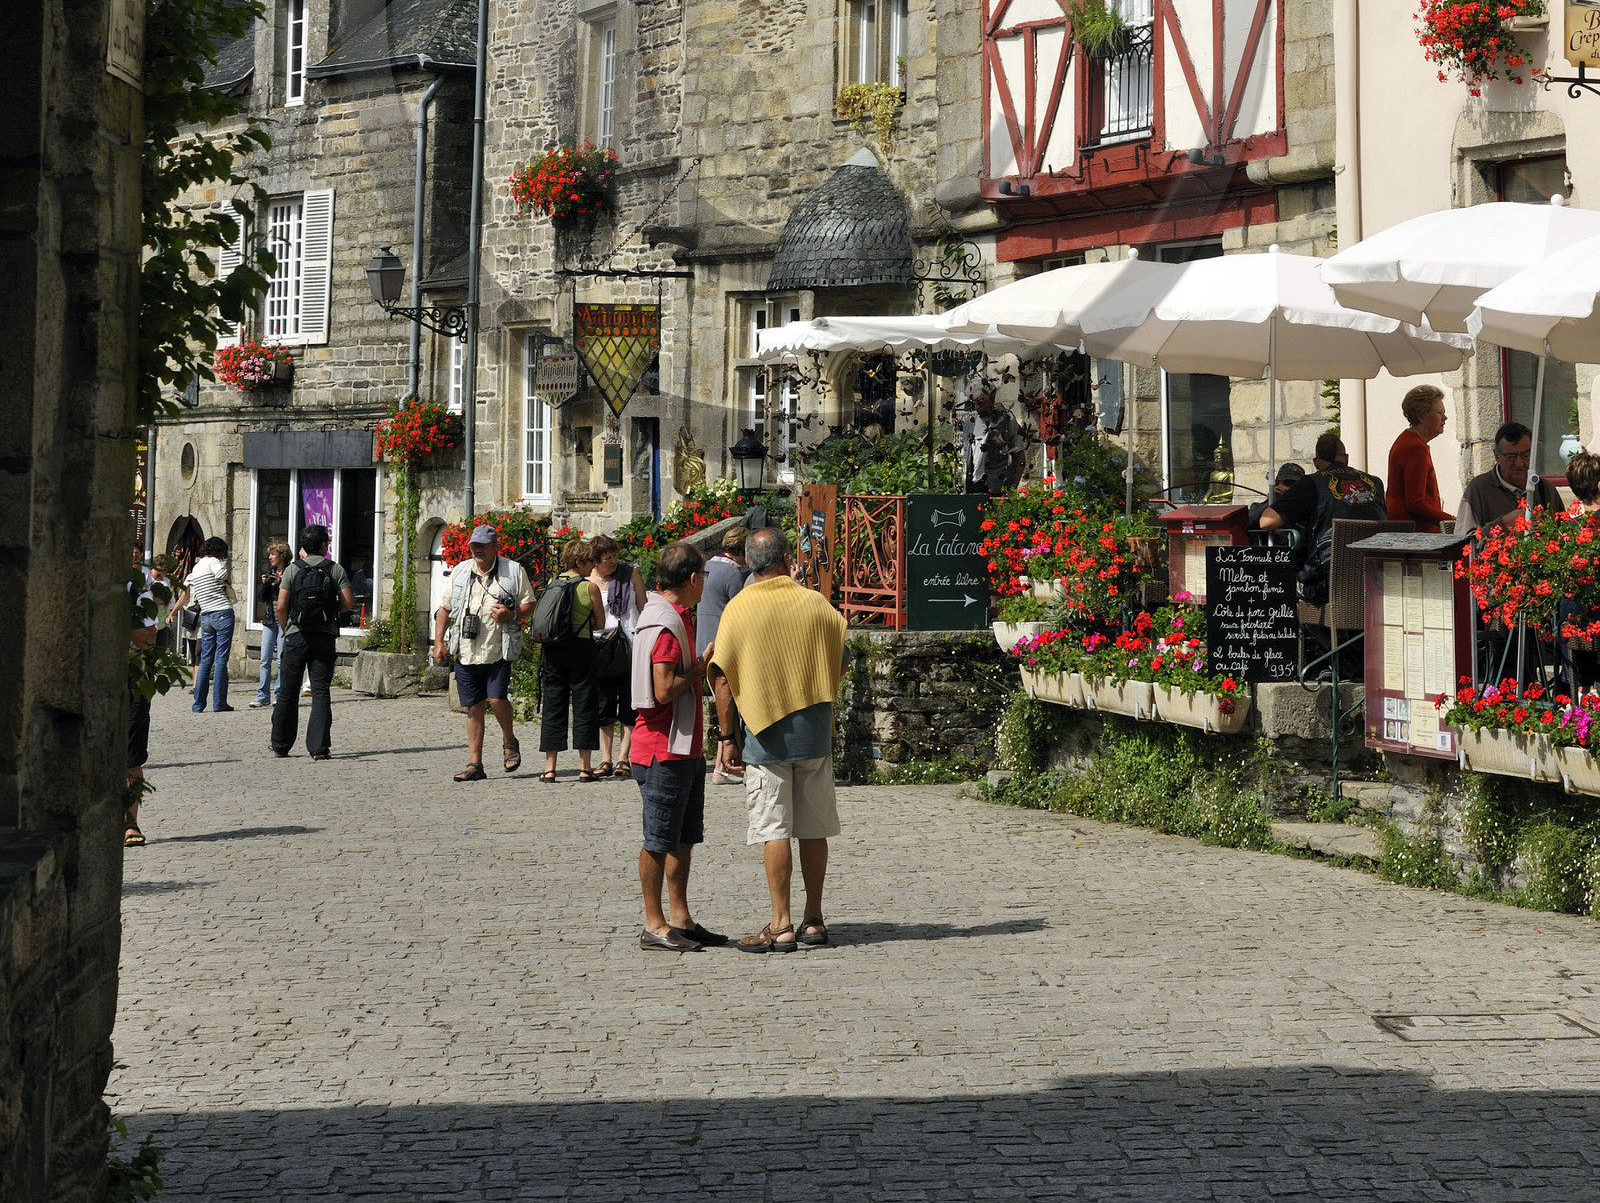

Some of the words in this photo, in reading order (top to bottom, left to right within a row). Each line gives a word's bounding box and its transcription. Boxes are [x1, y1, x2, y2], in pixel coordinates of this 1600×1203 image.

[908, 533, 930, 556] La
[935, 533, 984, 556] tatane
[1274, 549, 1290, 563] été
[923, 572, 951, 586] entrée
[955, 572, 980, 586] libre
[1220, 567, 1255, 583] Melon
[1258, 571, 1269, 583] et
[1225, 582, 1261, 601] jambon
[1262, 582, 1284, 600] fumé
[1213, 604, 1234, 617] Côte
[1235, 605, 1244, 617] de
[1247, 606, 1265, 622] porc
[1213, 646, 1223, 658] 2
[1227, 644, 1251, 658] boules
[1252, 649, 1261, 659] de
[1264, 647, 1283, 668] glace
[1215, 662, 1229, 670] ou
[1230, 659, 1249, 677] café
